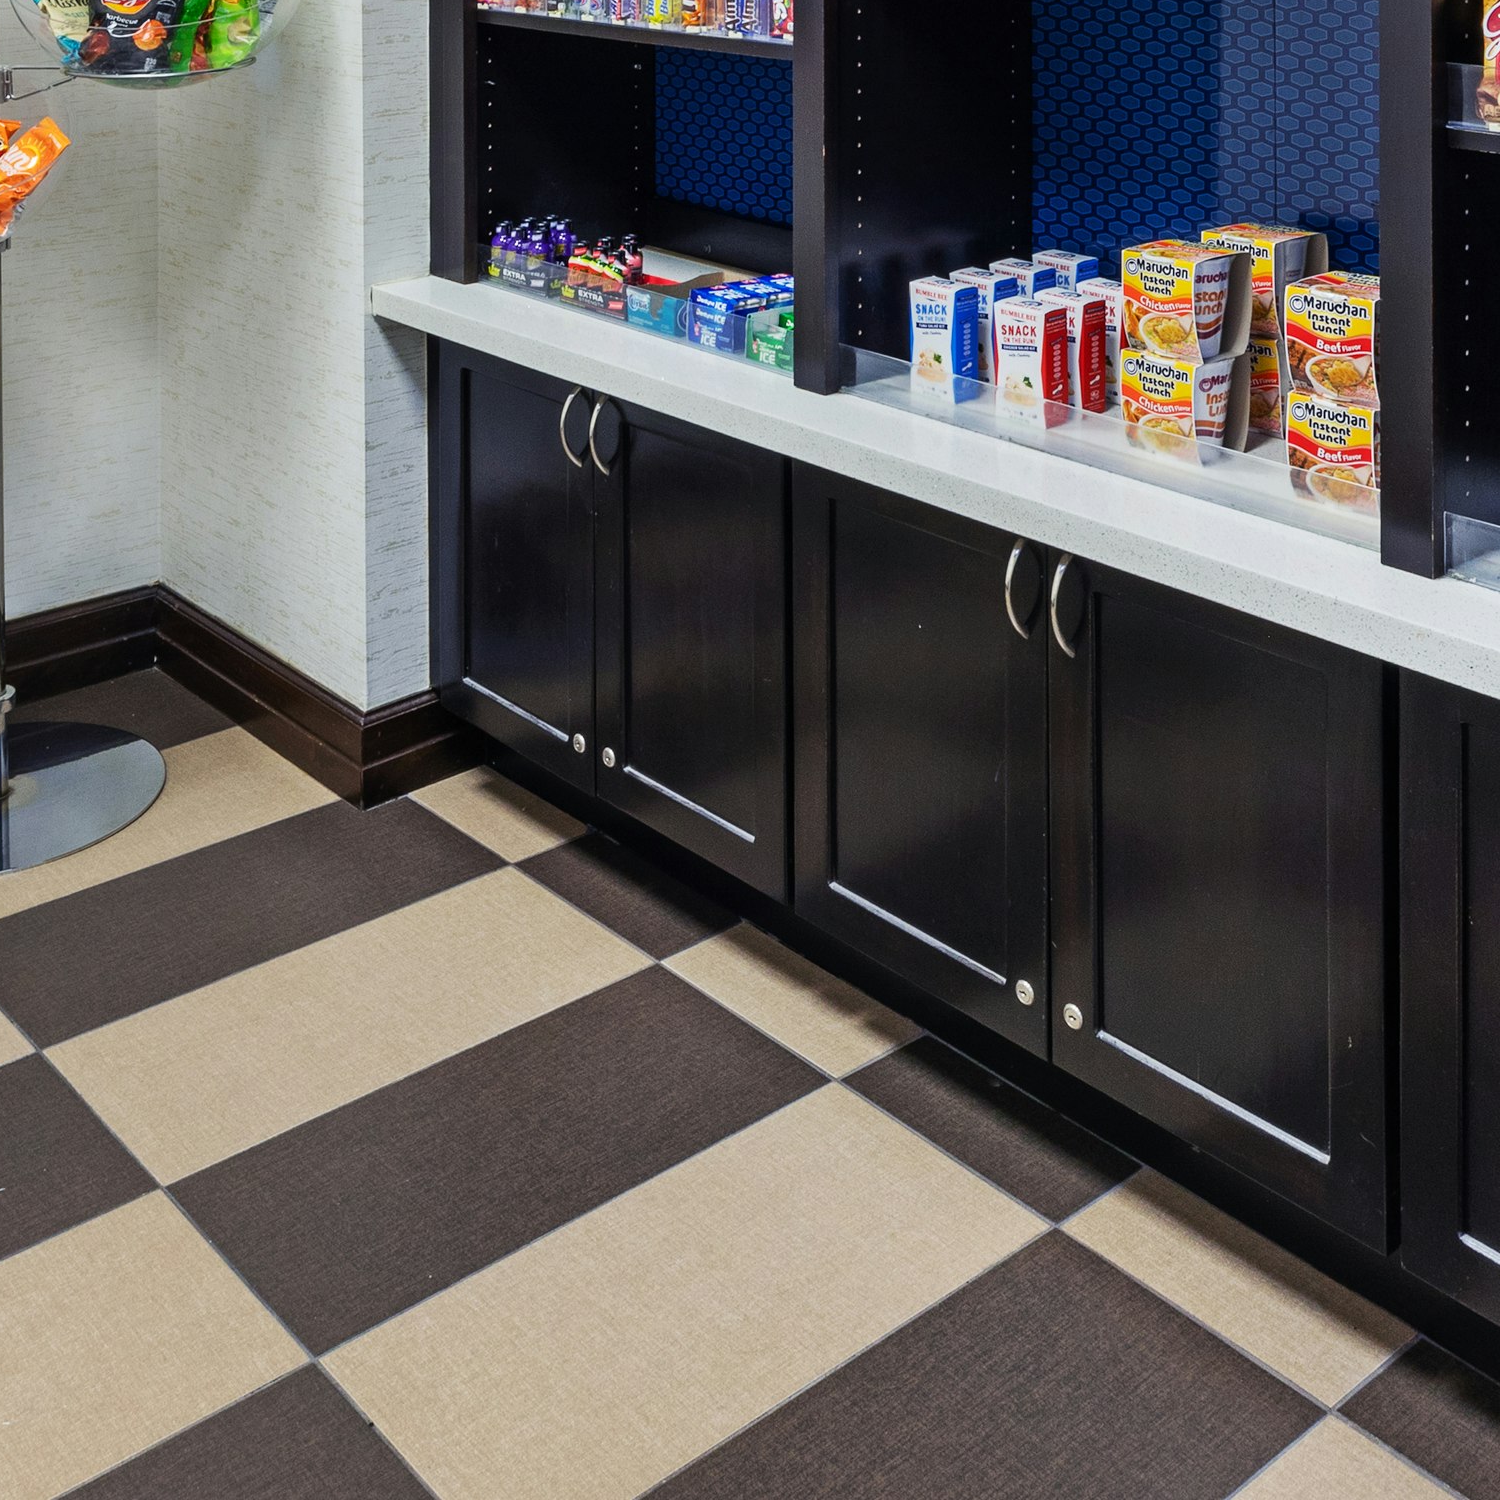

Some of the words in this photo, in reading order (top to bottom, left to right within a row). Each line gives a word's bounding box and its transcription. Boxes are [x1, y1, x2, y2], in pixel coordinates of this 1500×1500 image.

[502, 269, 526, 281] EXTRA
[1137, 258, 1188, 279] Maruchan
[1140, 272, 1176, 287] Instant
[915, 288, 936, 298] BUMBLE
[1143, 282, 1171, 295] Lunch
[578, 290, 604, 303] EXTRA
[1140, 295, 1175, 311] Chicken
[714, 300, 727, 312] ICE
[915, 303, 947, 315] SNACK
[1303, 295, 1367, 318] Maruchan
[714, 314, 726, 326] ICE
[1001, 309, 1023, 319] BUMBLE
[1308, 311, 1351, 327] Instant
[1001, 324, 1036, 337] SNACK
[1312, 321, 1346, 336] Lunch
[700, 336, 716, 348] ICE
[1316, 338, 1341, 352] Beef
[1341, 344, 1361, 352] Flavor
[759, 353, 776, 366] ICE
[1136, 358, 1188, 382] Maruchan
[1138, 373, 1175, 389] Instant
[1142, 383, 1171, 397] Lunch
[1138, 396, 1175, 413] Chicken
[1174, 404, 1191, 412] Flavor
[1304, 403, 1366, 428] Maruchan
[1309, 418, 1351, 437] Instant
[1313, 430, 1346, 446] Lunch
[1317, 447, 1341, 462] Beef
